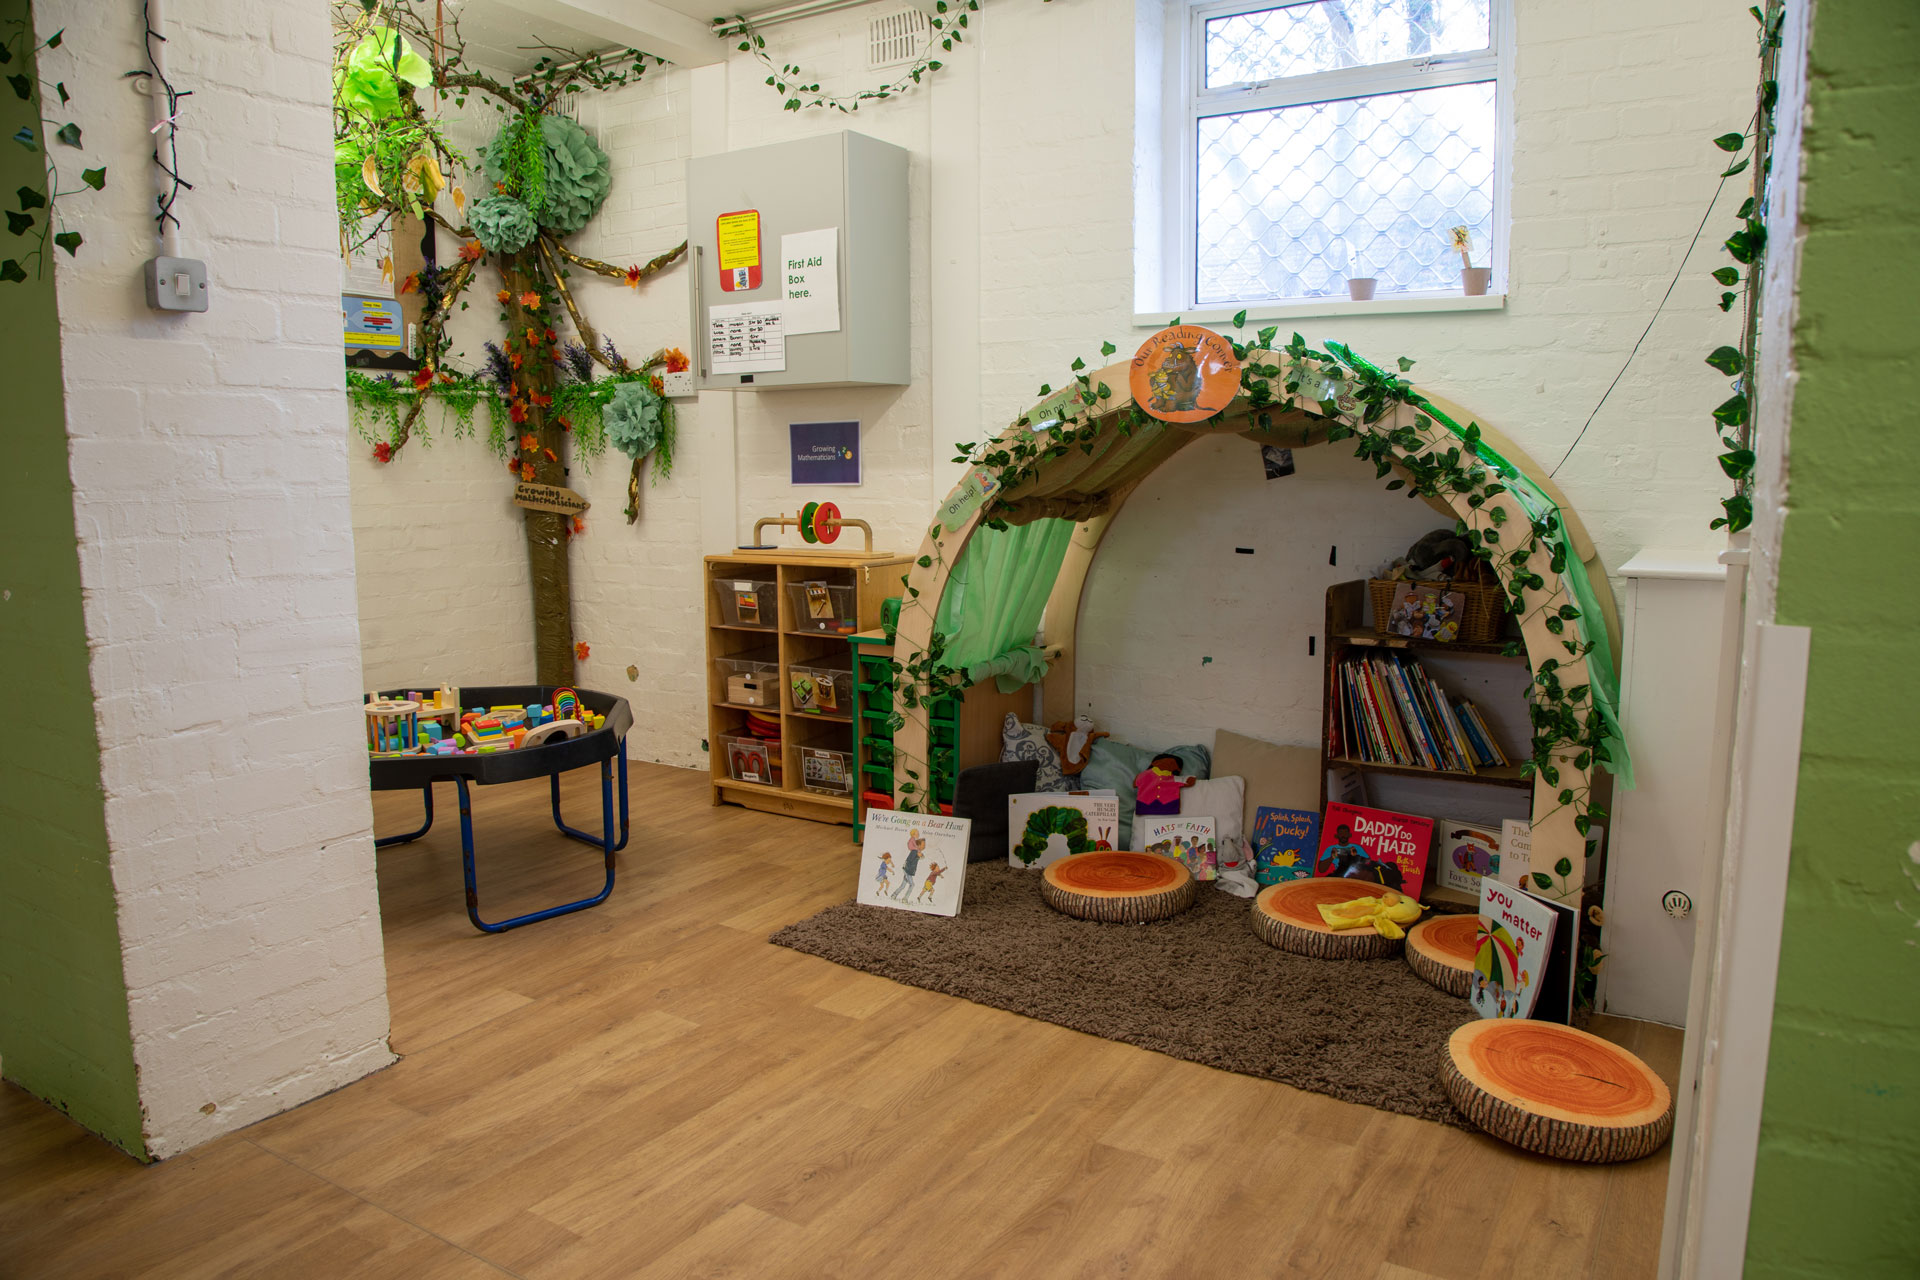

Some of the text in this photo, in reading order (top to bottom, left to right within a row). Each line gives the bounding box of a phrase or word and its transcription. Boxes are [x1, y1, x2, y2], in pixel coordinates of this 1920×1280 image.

[788, 256, 823, 270] First Aid
[788, 275, 805, 285] Box
[788, 289, 812, 299] here.
[1135, 326, 1234, 373] Our Reading Corner
[1039, 400, 1068, 419] Oh no!
[812, 445, 836, 453] Growing
[518, 485, 560, 500] Growing
[949, 484, 977, 515] Oh help!
[872, 813, 889, 823] We're
[890, 815, 911, 827] Going
[927, 819, 944, 829] Bear
[945, 821, 964, 831] Hunt
[1153, 823, 1176, 836] HATS
[1186, 822, 1211, 835] FAITH
[1354, 816, 1403, 838] DADDY
[1400, 831, 1412, 840] DO
[1275, 824, 1310, 839] Ducky!
[1512, 826, 1530, 838] The
[1360, 836, 1416, 856] MY HAIR
[1511, 839, 1531, 851] Cam
[1509, 851, 1520, 860] to
[1449, 870, 1468, 884] Fox's
[1486, 888, 1513, 909] you
[1502, 909, 1543, 941] matter
